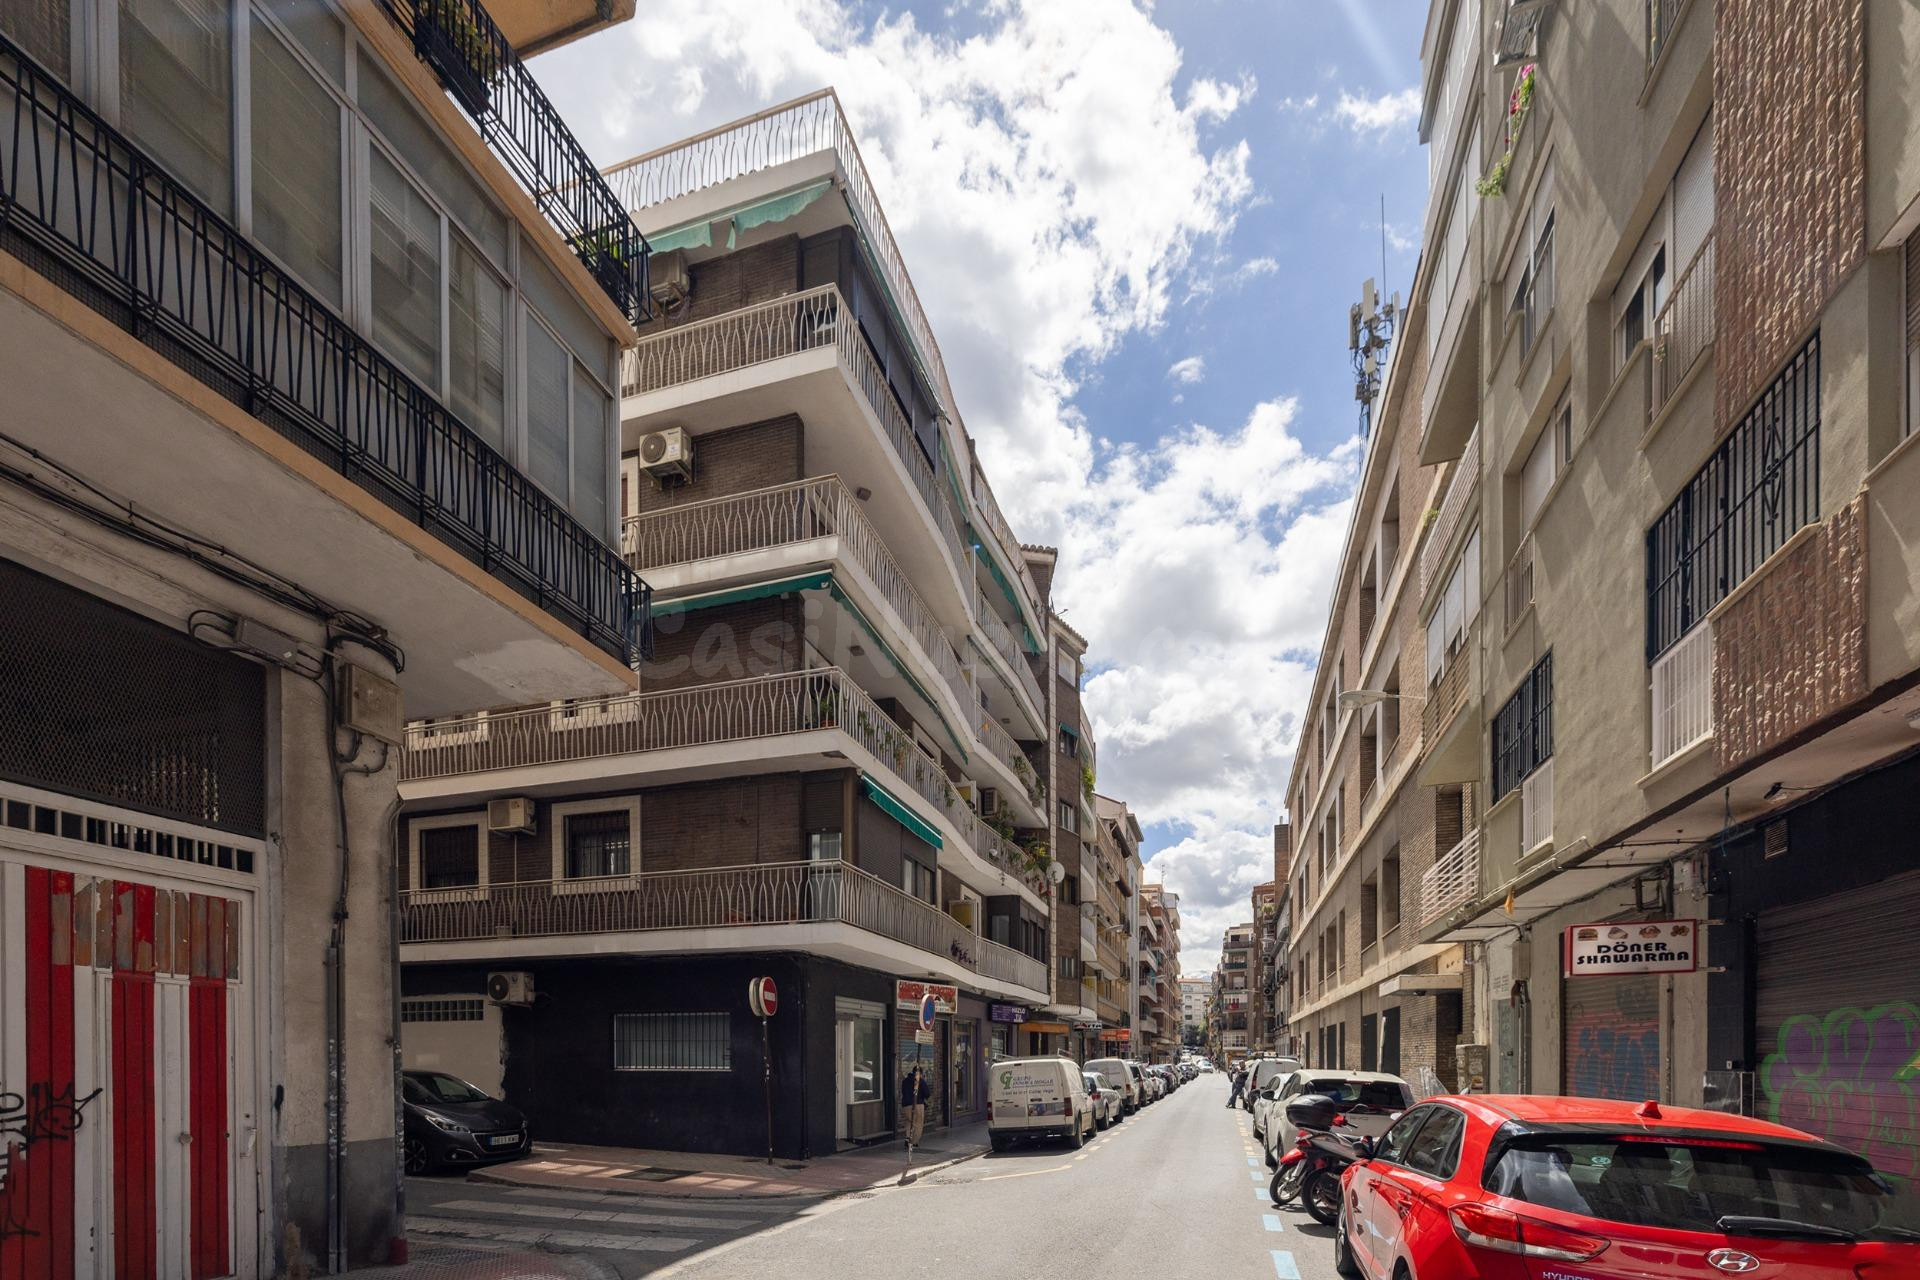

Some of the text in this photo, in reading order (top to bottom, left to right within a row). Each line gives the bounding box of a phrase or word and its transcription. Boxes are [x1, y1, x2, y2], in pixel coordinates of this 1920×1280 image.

[1597, 941, 1667, 954] DÖNER
[1576, 951, 1689, 965] SHAWARMA
[1542, 1271, 1594, 1280] HYUND
